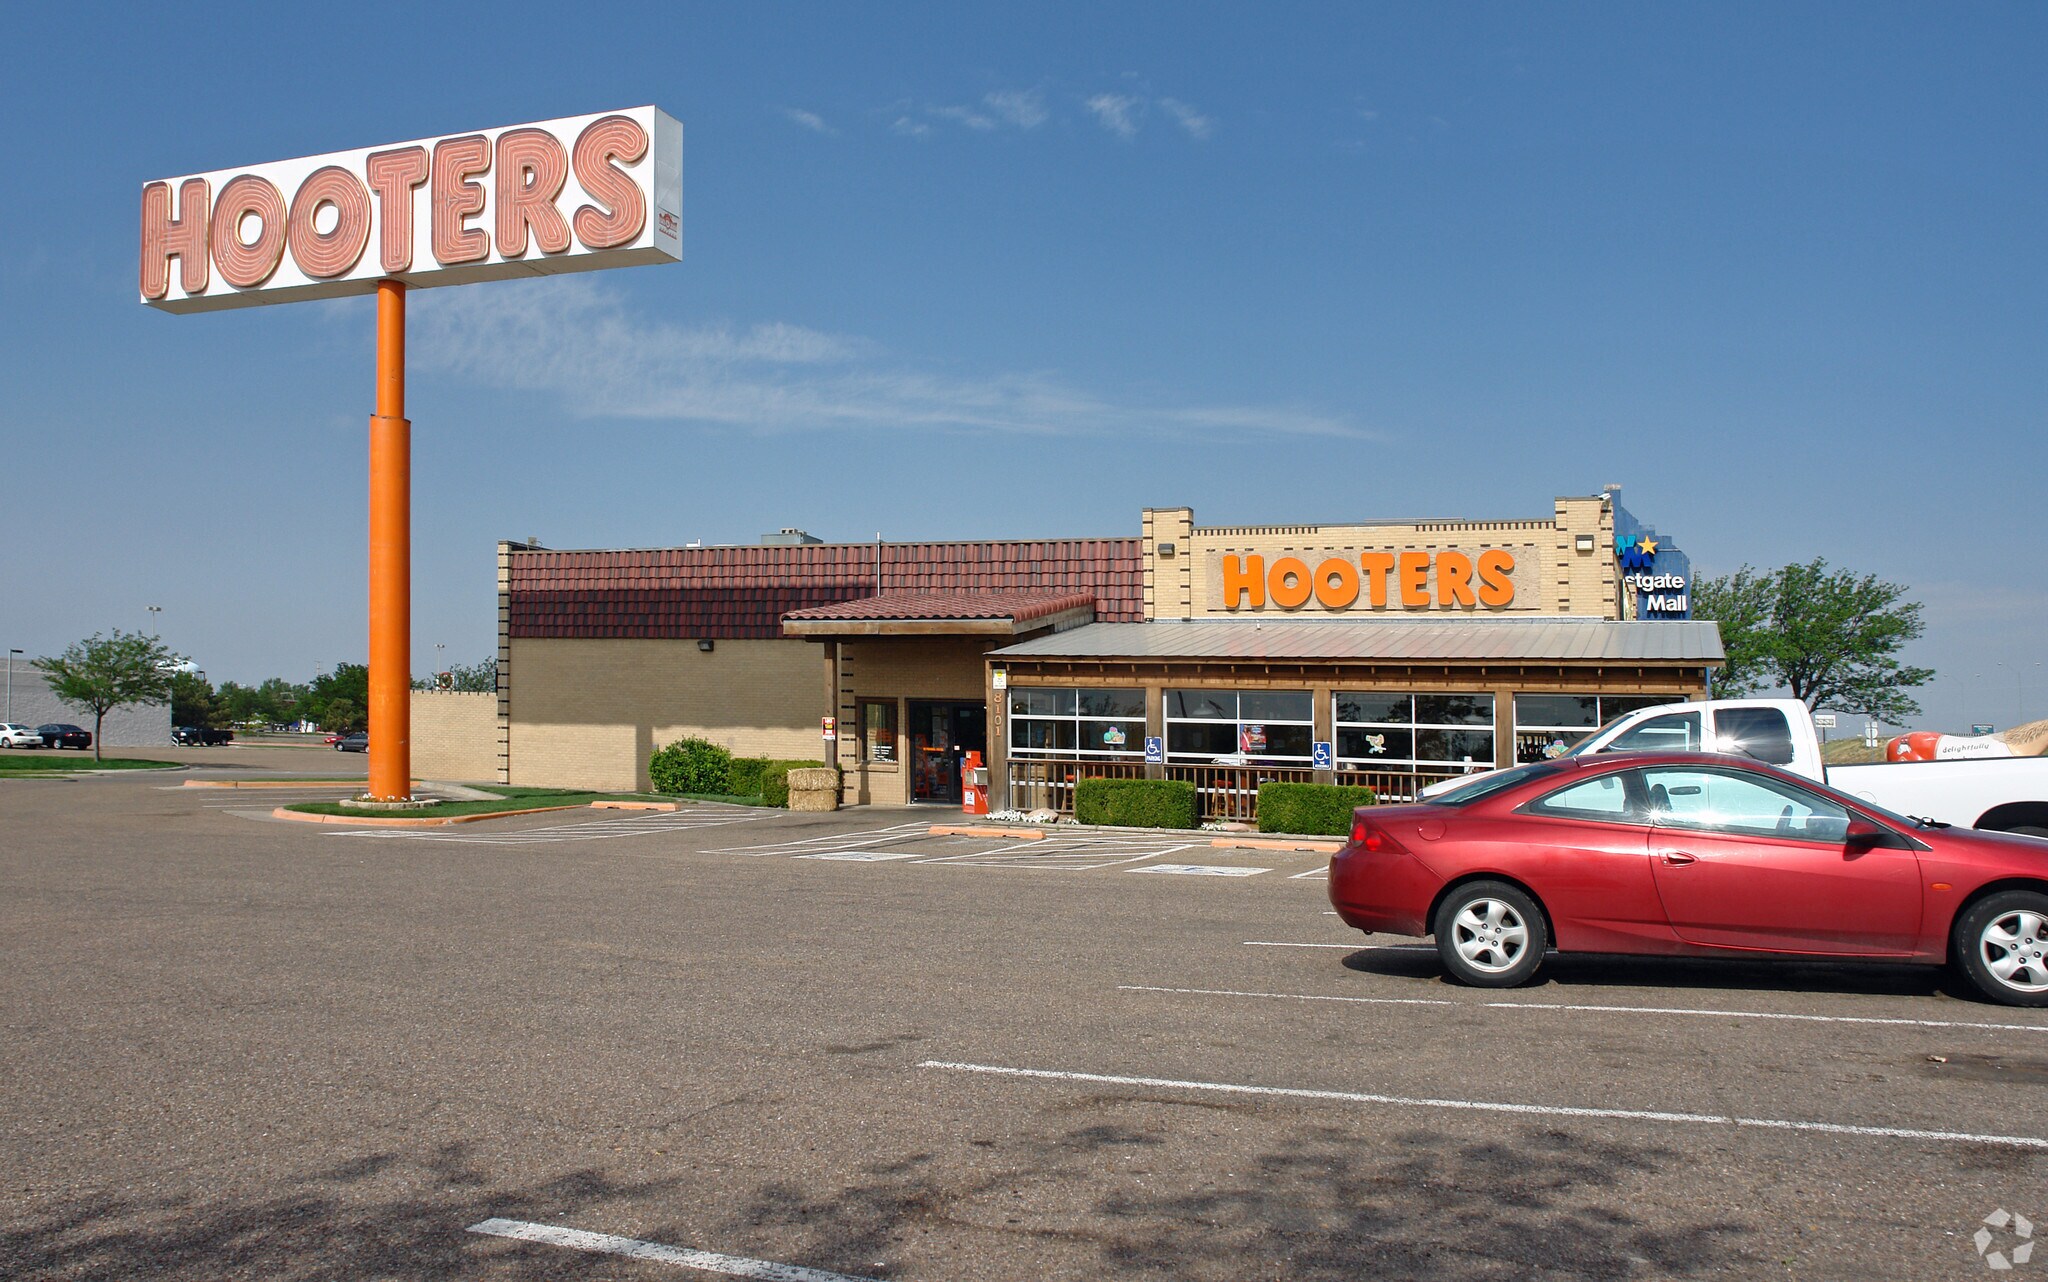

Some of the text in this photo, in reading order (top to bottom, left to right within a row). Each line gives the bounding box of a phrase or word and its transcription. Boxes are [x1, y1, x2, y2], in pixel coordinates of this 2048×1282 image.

[140, 115, 648, 299] HOOTERS
[1222, 549, 1516, 609] HOOTERS
[1647, 594, 1687, 611] Mall
[994, 692, 1002, 736] 8101
[1942, 743, 1989, 753] delightfully
